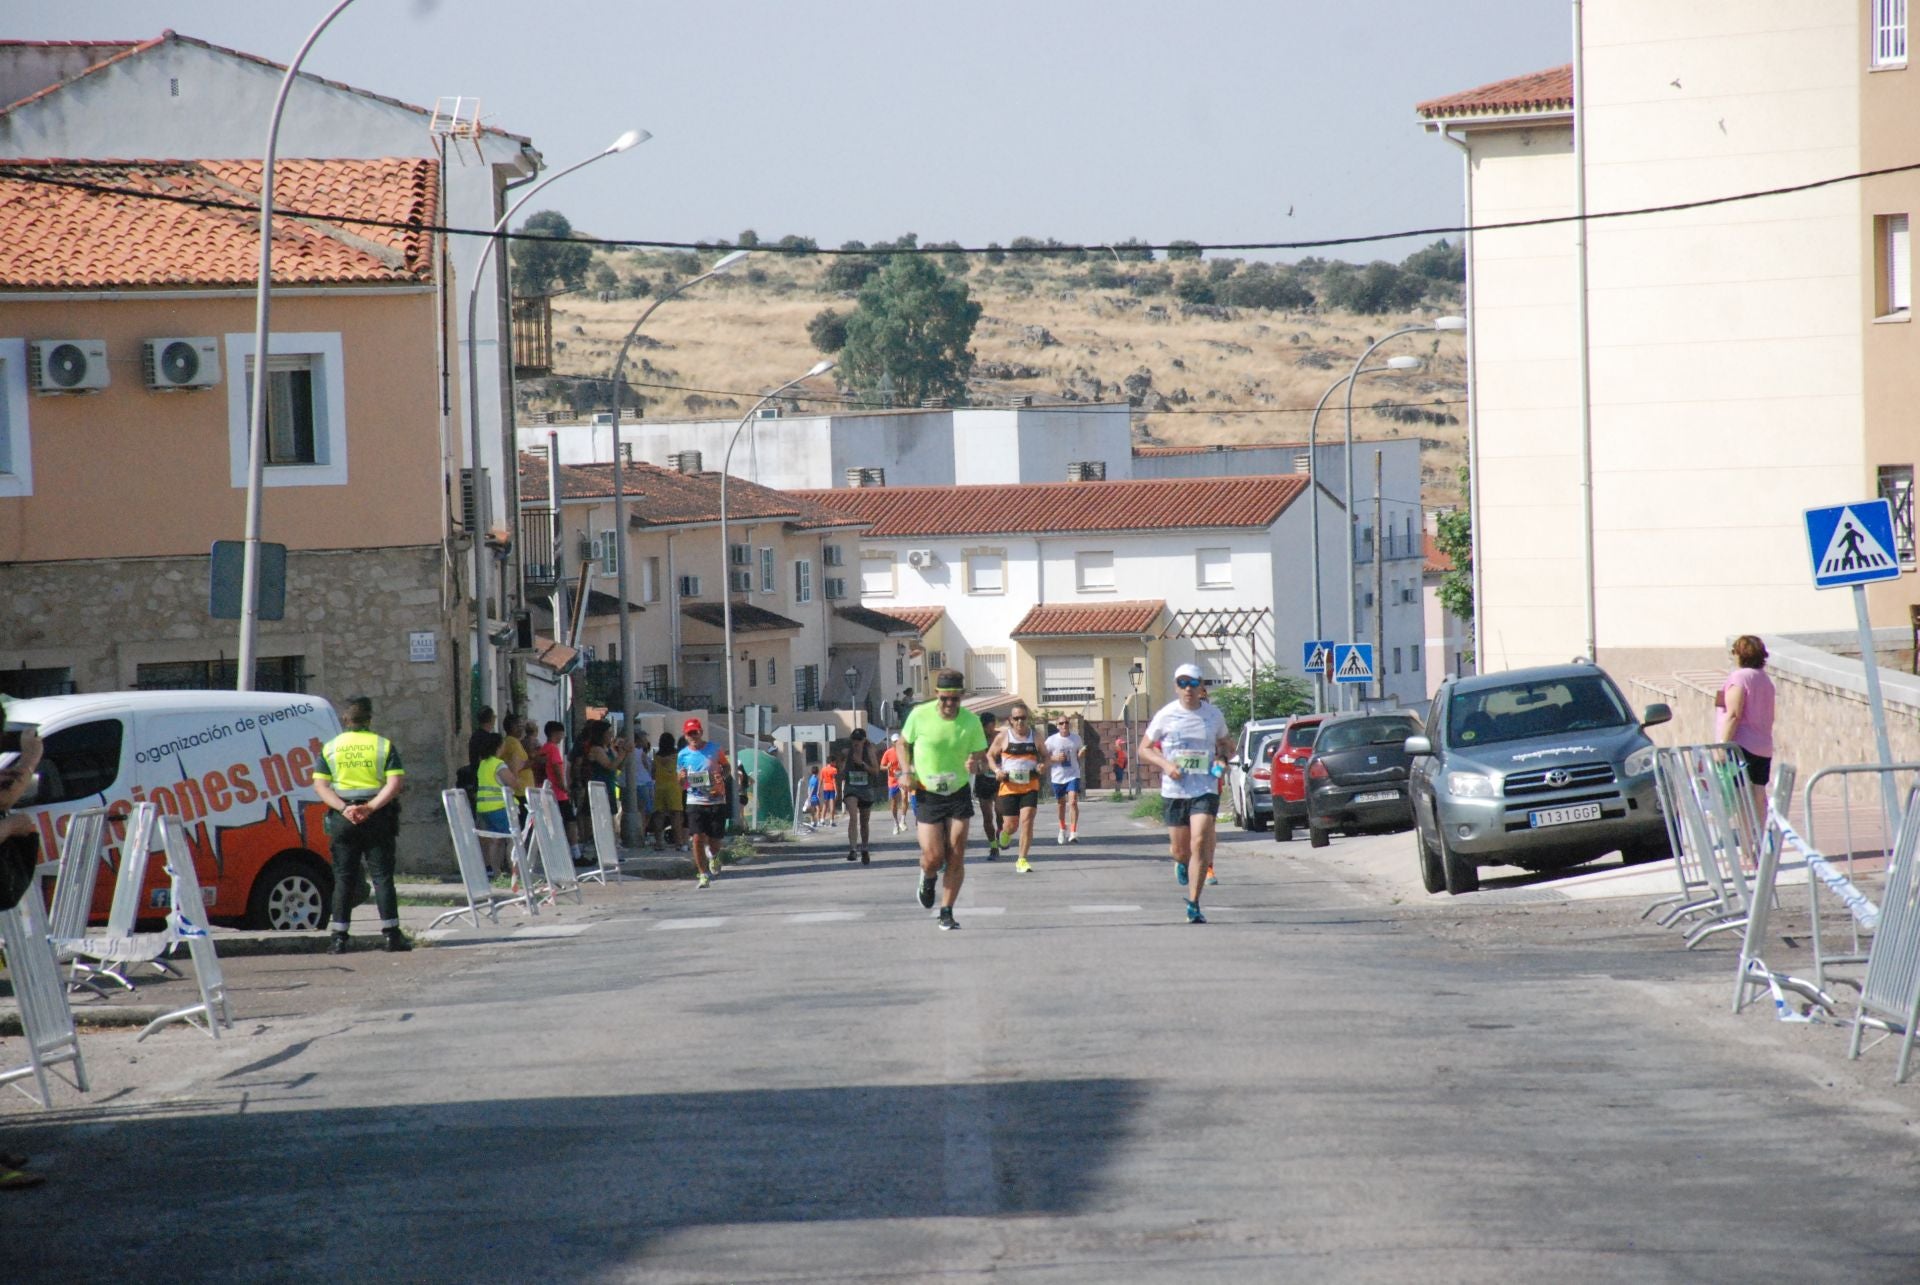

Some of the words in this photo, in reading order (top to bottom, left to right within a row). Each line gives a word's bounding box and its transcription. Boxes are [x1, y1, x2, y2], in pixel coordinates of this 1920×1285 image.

[135, 719, 233, 764] organización
[235, 713, 256, 734] de
[258, 702, 315, 726] eventos
[336, 744, 375, 752] GUARDIA
[344, 752, 365, 760] CIVIL
[1183, 758, 1200, 769] 221
